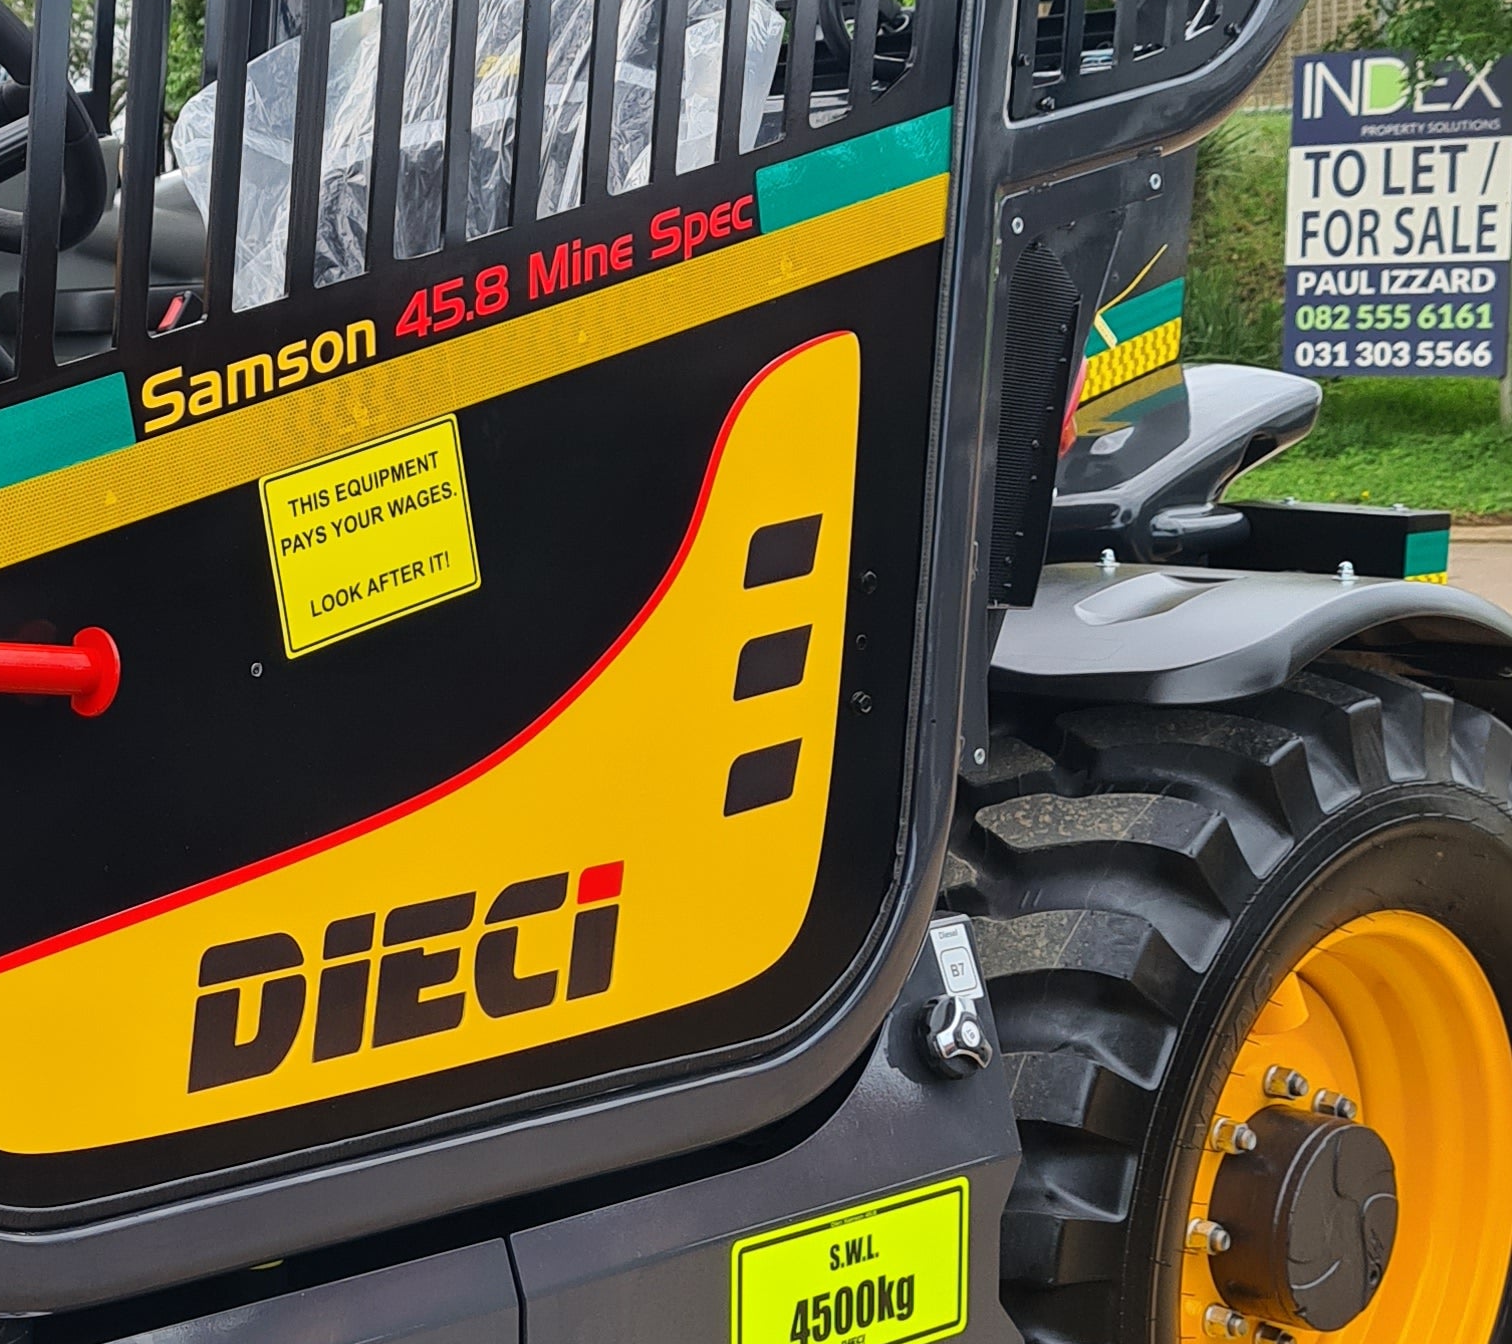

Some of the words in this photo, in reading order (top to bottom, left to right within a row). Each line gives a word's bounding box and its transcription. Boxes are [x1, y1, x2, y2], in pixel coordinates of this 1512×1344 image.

[1302, 56, 1502, 119] INDEX
[1360, 121, 1426, 137] PROPERTY
[1428, 117, 1502, 134] SOLUTIONS
[1304, 149, 1367, 199] TO
[1382, 143, 1469, 197] LET
[1299, 209, 1380, 258] FOR
[1393, 204, 1498, 256] SALE
[1296, 269, 1376, 296] PAUL
[1380, 267, 1496, 295] IZZARD
[141, 318, 377, 433] Samson
[394, 271, 510, 338] 45.8
[527, 233, 635, 301] Mine
[647, 193, 755, 262] Spec
[1295, 304, 1351, 331] 082
[1355, 303, 1411, 330] 555
[1417, 302, 1493, 330] 6161
[1294, 341, 1350, 368] 031
[1354, 341, 1411, 368] 303
[1414, 340, 1493, 368] 5566
[288, 489, 330, 518] THIS
[335, 451, 439, 503] EQUIPMENT
[280, 525, 327, 557] PAYS
[331, 506, 384, 538] YOUR
[387, 481, 457, 519] WAGES.
[310, 582, 363, 618] LOOK
[367, 560, 425, 597] AFTER
[429, 550, 451, 575] IT!
[950, 962, 965, 978] B7
[829, 1233, 880, 1272] S.W.L.
